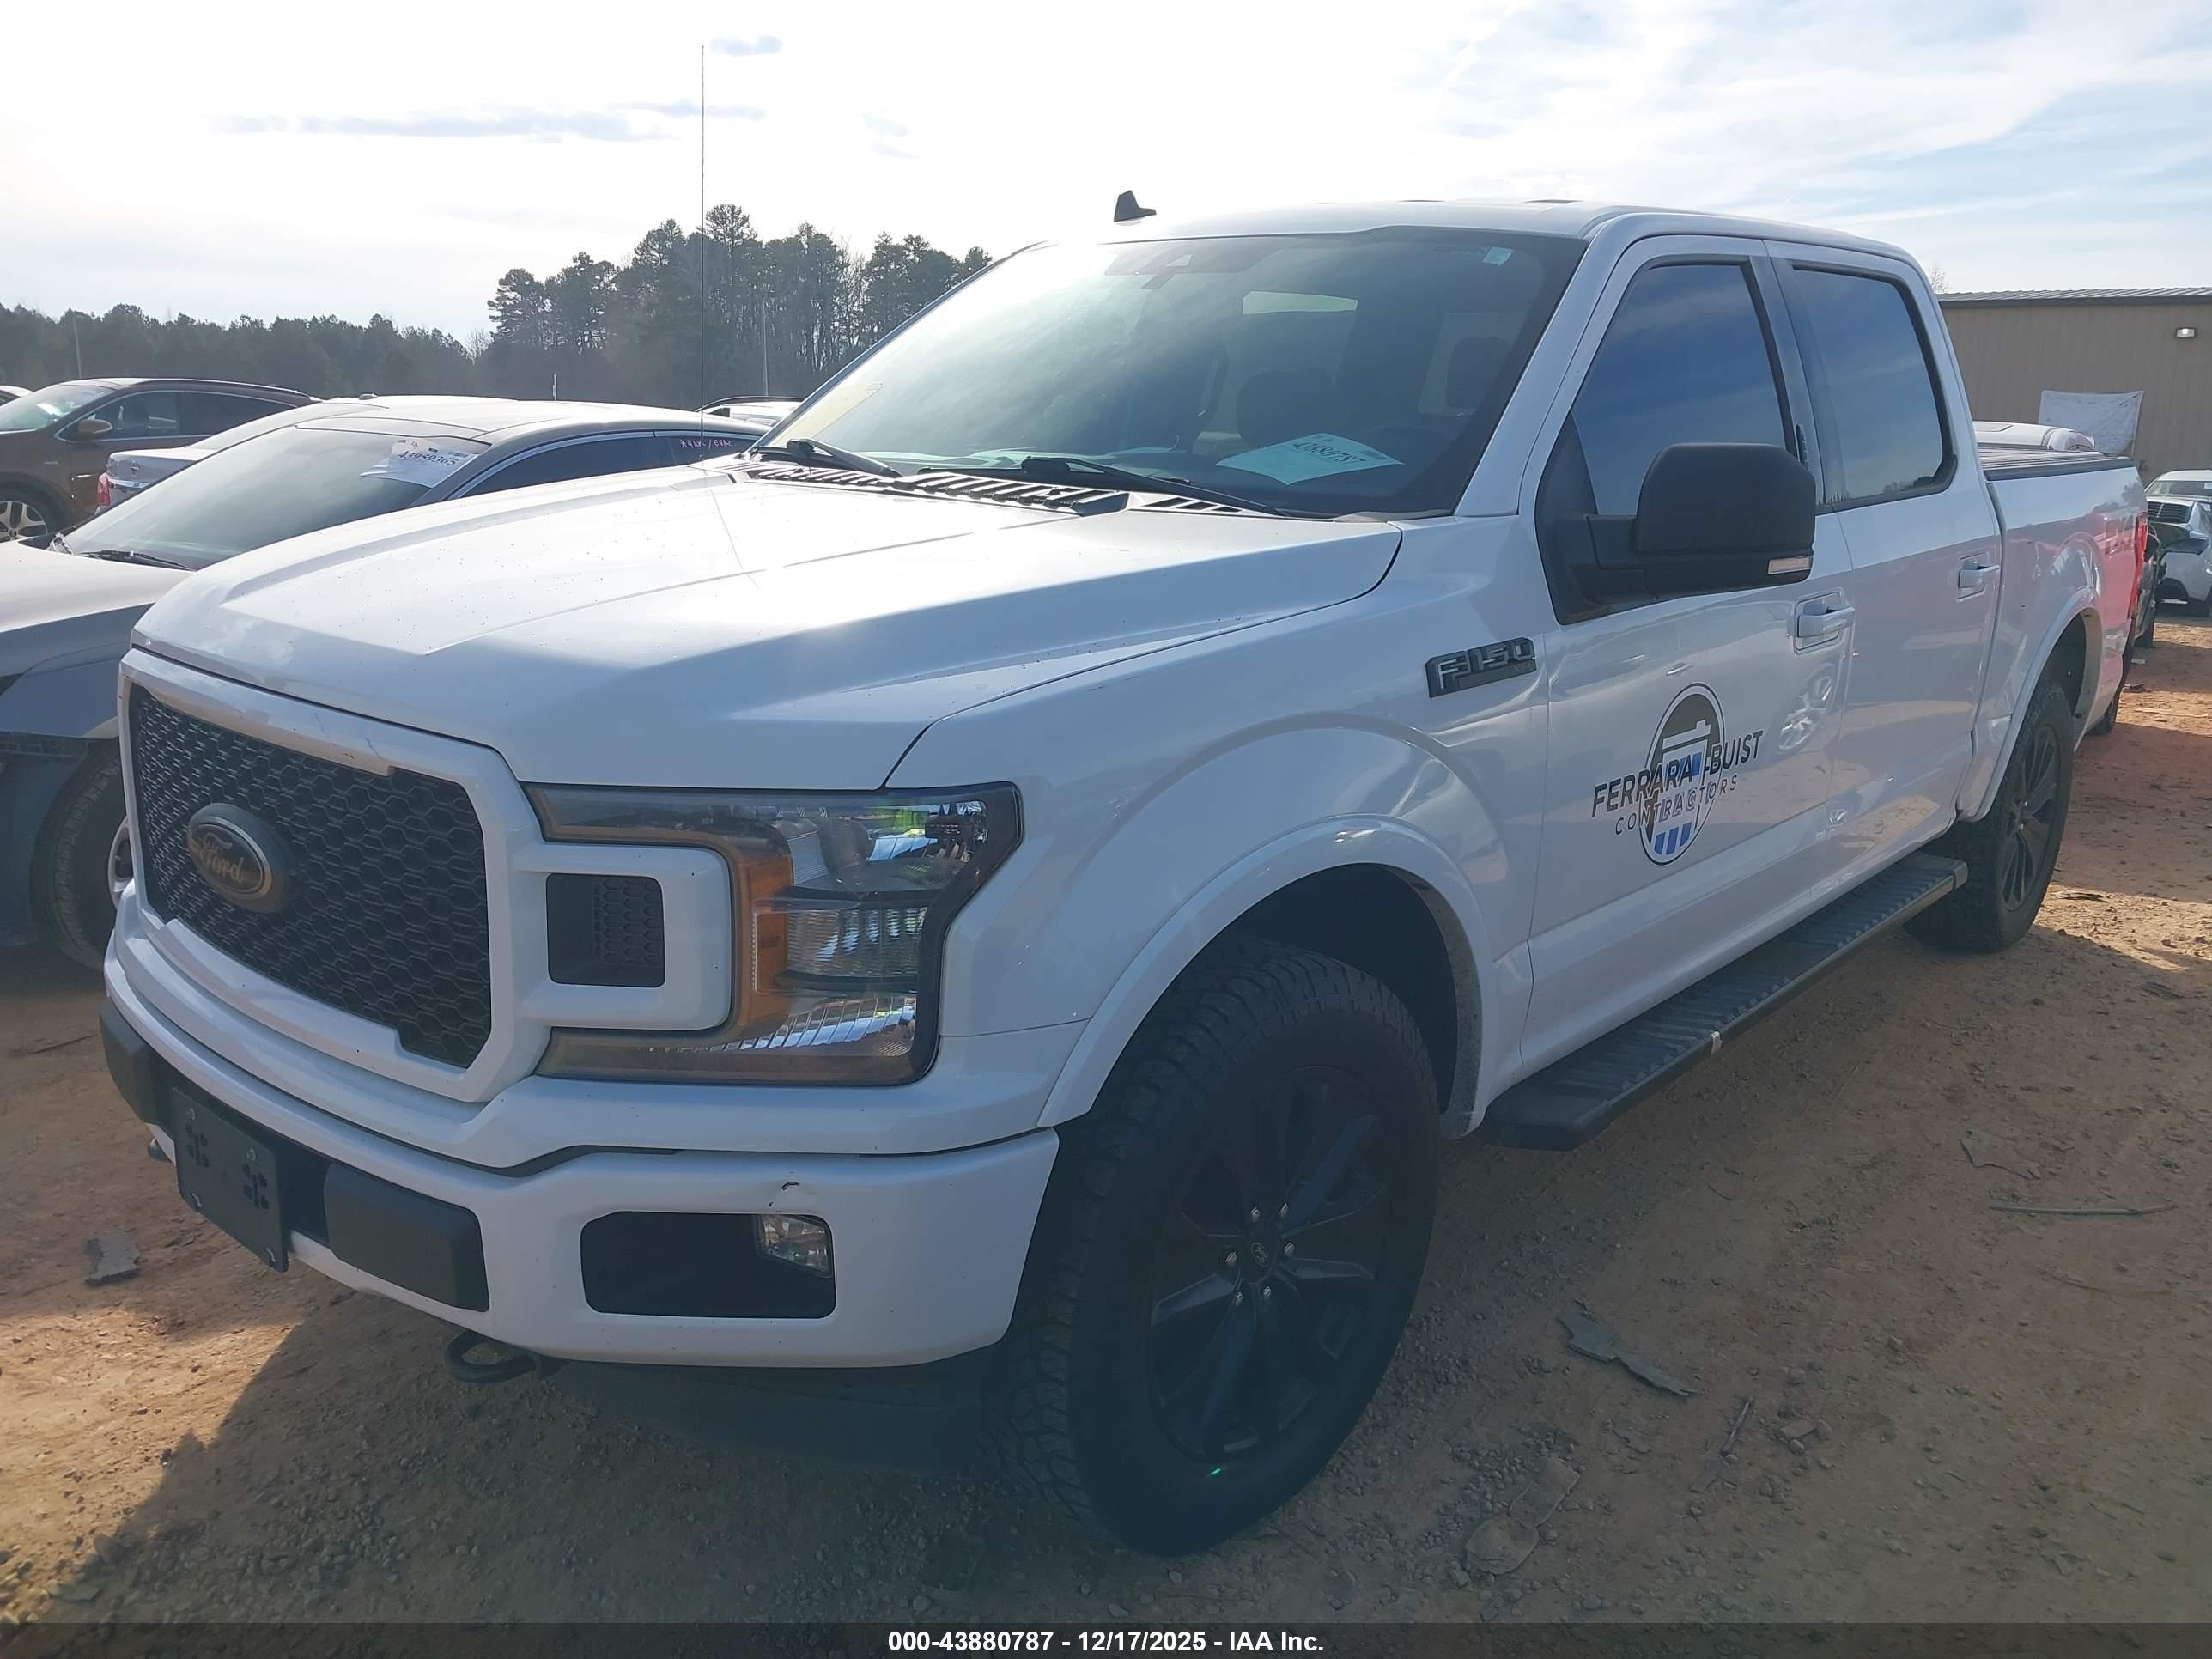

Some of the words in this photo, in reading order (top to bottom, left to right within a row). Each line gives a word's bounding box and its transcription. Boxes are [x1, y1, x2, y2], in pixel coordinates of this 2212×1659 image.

[398, 450, 459, 465] 43959365
[1592, 754, 1692, 818] FERRARA
[1614, 775, 1738, 836] CONTRACTORS
[198, 831, 245, 884] Ford
